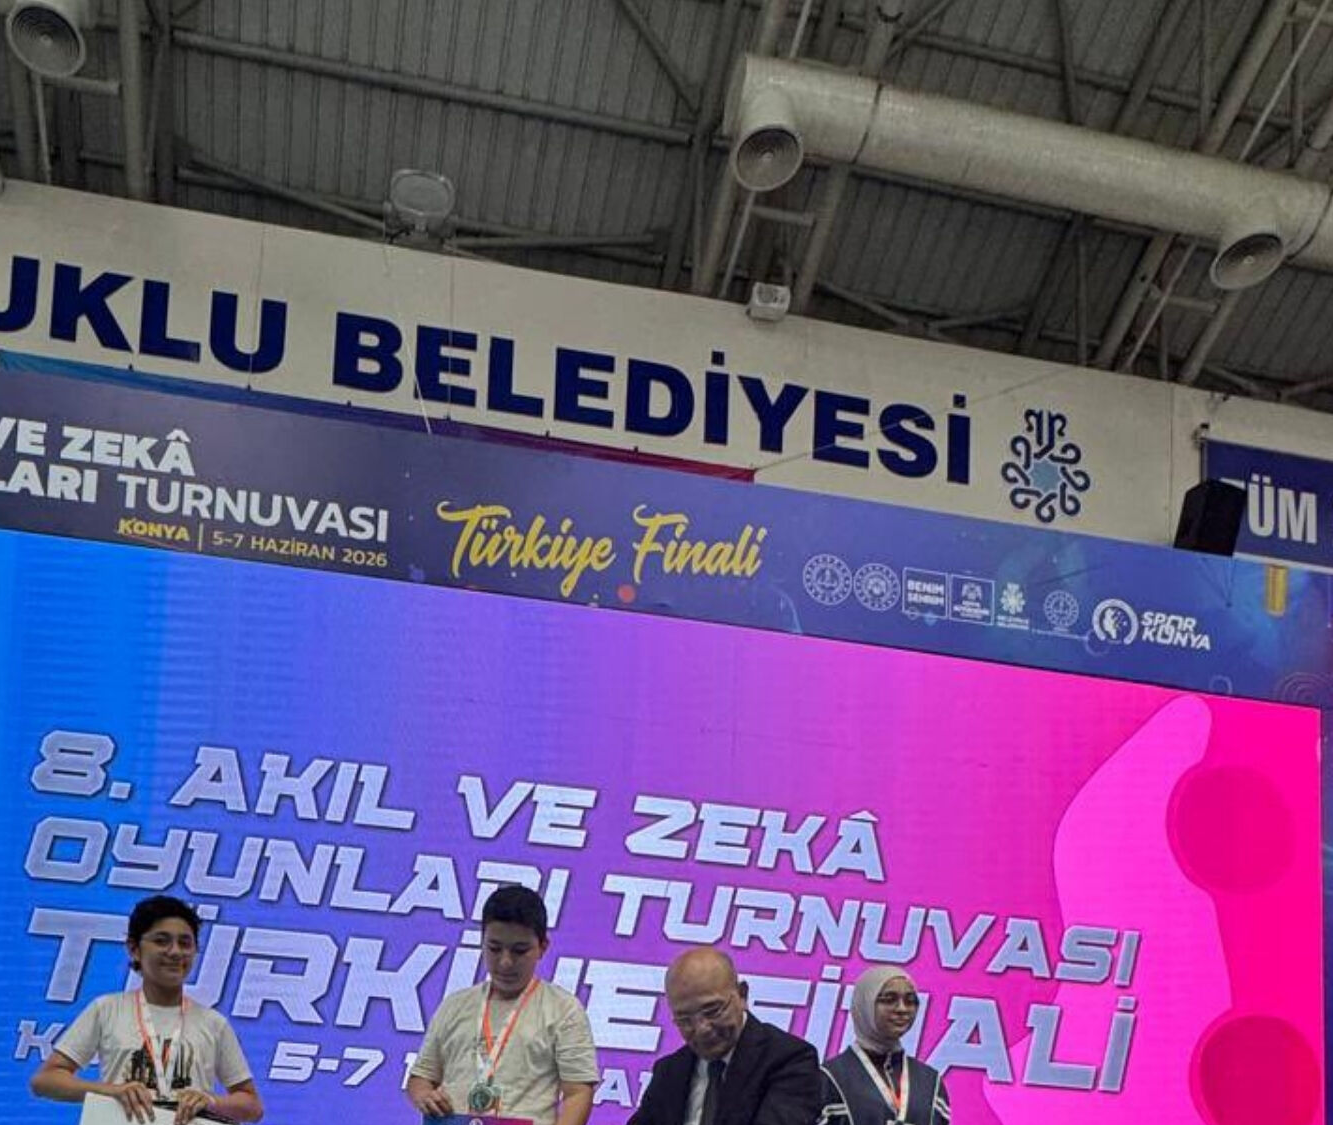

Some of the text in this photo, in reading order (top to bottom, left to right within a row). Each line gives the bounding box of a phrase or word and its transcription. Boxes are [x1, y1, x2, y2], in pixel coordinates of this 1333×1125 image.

[333, 311, 971, 485] BELEDİYESİ
[61, 426, 195, 477] ZEKÂ
[117, 473, 390, 543] TURNUVASI
[118, 517, 389, 568] KONYA 5-7 HAZİRAN 2026
[1219, 473, 1318, 545] ÜM
[436, 500, 768, 597] Türkiye Finali
[1141, 612, 1197, 632] SPOR
[30, 729, 886, 882] 8. AKIL VE ZEKÂ
[602, 874, 1141, 987] TURNUVASI
[268, 1041, 388, 1088] 5-7
